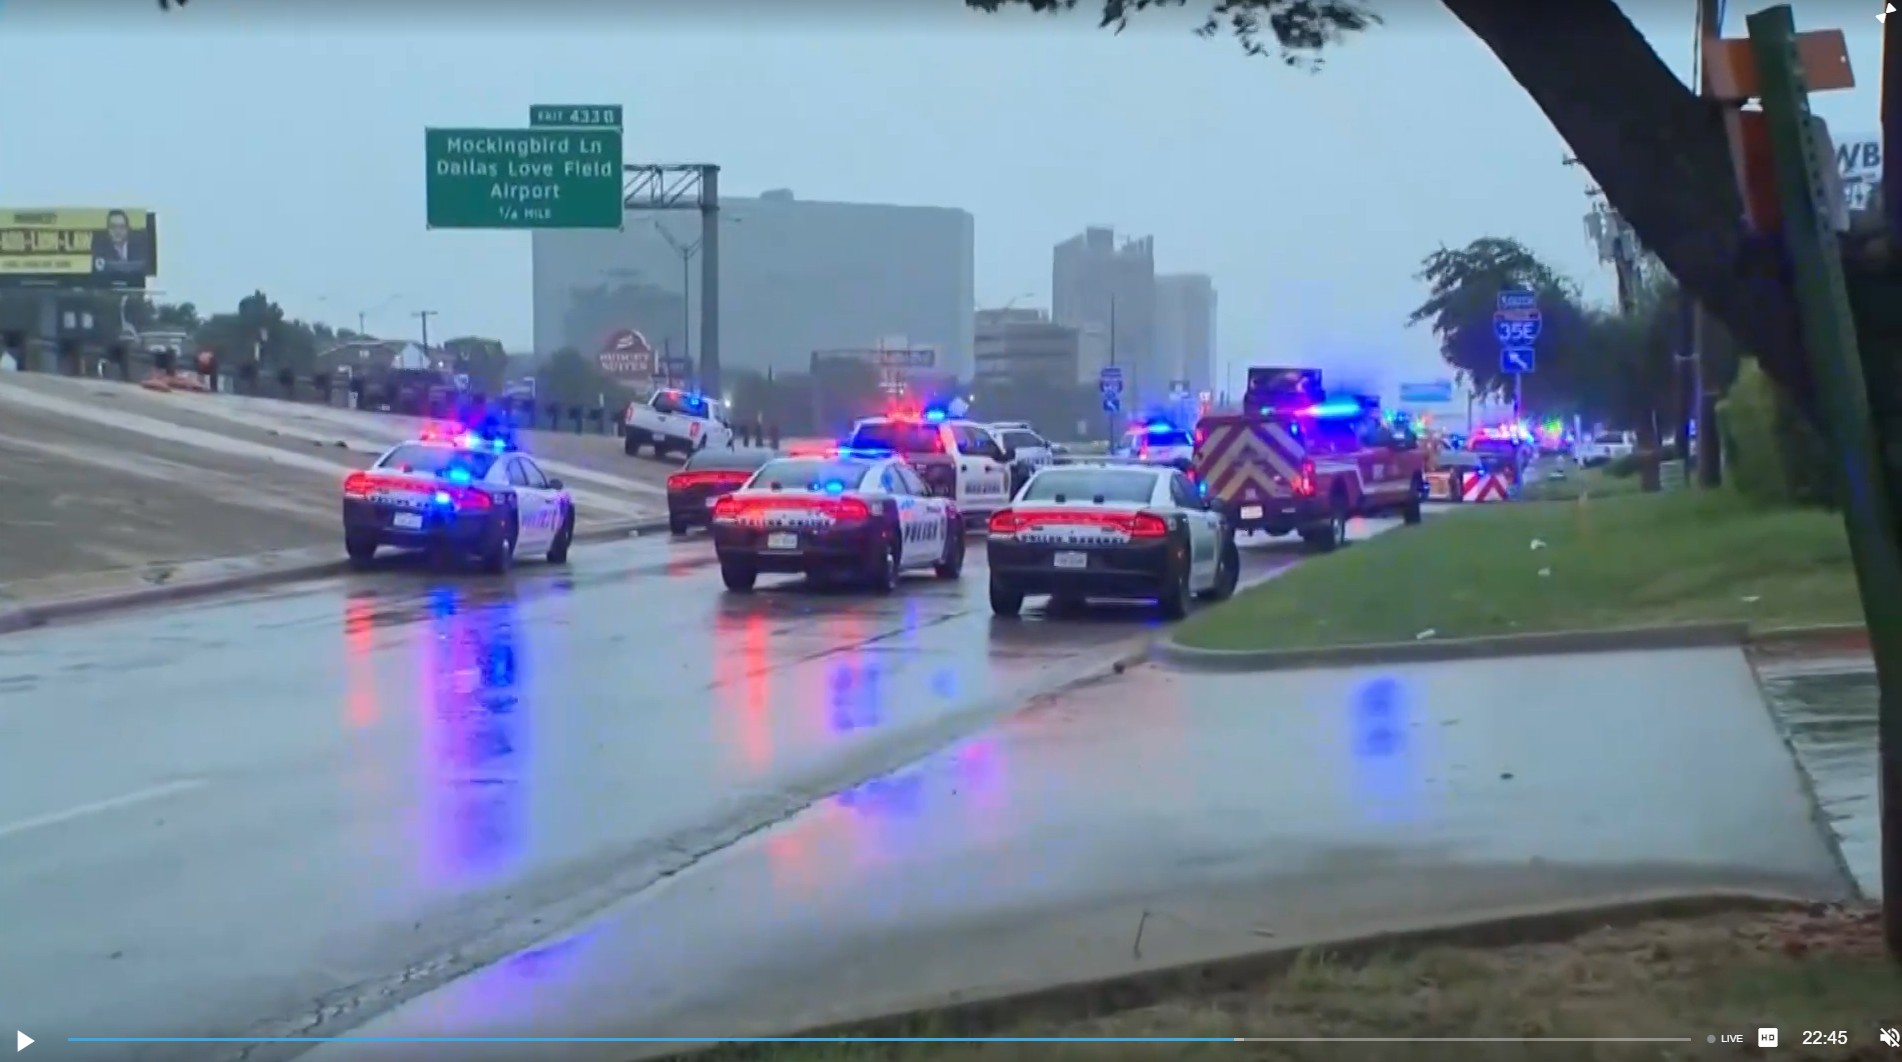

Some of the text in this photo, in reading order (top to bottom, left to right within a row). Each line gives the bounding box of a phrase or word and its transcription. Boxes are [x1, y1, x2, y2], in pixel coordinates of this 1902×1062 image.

[538, 111, 562, 122] EXIT
[447, 136, 602, 158] Mockingbird Ln
[437, 159, 612, 177] Dallas Love Field
[490, 182, 560, 202] Airport
[524, 208, 551, 219] MILE
[1499, 322, 1535, 340] 35E
[903, 520, 939, 543] POLICE
